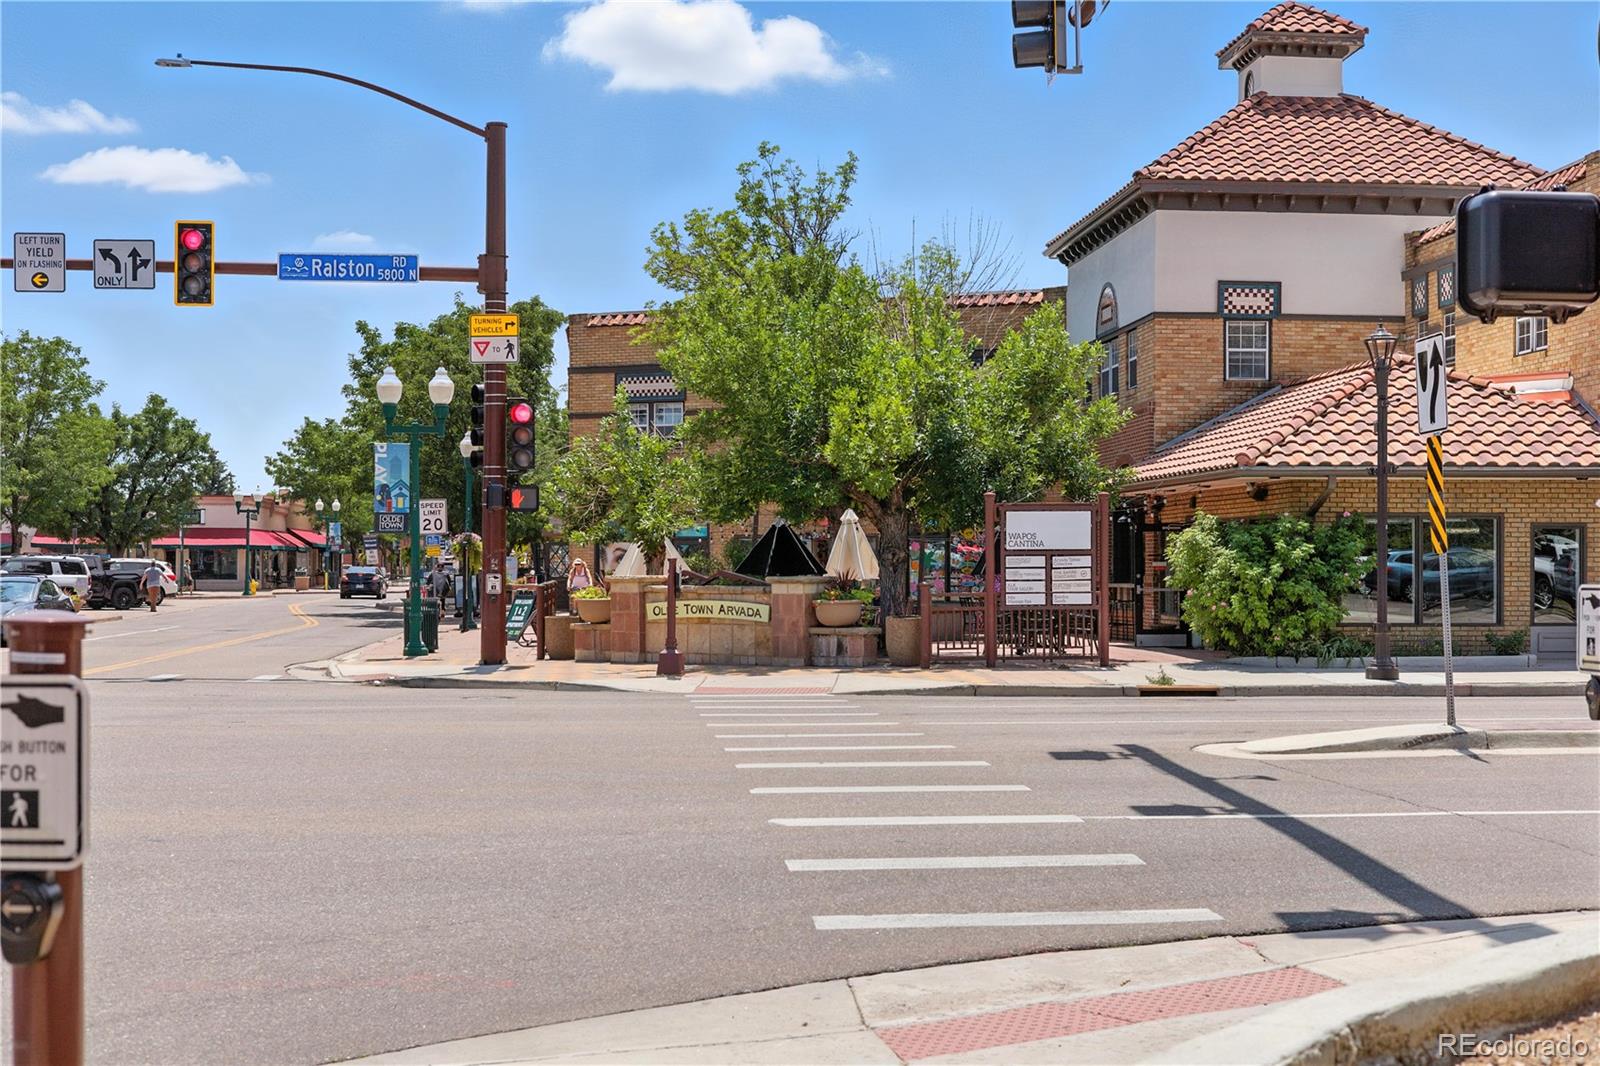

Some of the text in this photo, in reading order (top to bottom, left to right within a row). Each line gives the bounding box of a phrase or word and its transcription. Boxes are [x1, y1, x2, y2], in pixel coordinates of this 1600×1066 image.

[19, 236, 37, 244] LEFT
[26, 247, 54, 257] YIELD
[17, 260, 62, 268] ON FLASHING
[392, 256, 407, 267] RD
[311, 258, 375, 277] Ralston
[377, 268, 416, 280] 5800 N
[97, 276, 123, 286] ONLY
[374, 443, 388, 484] PLAY
[422, 518, 443, 531] 20
[1008, 540, 1045, 548] CANTINA
[652, 603, 762, 618] OLE TOWN ARVADA
[18, 740, 66, 754] BUTTON
